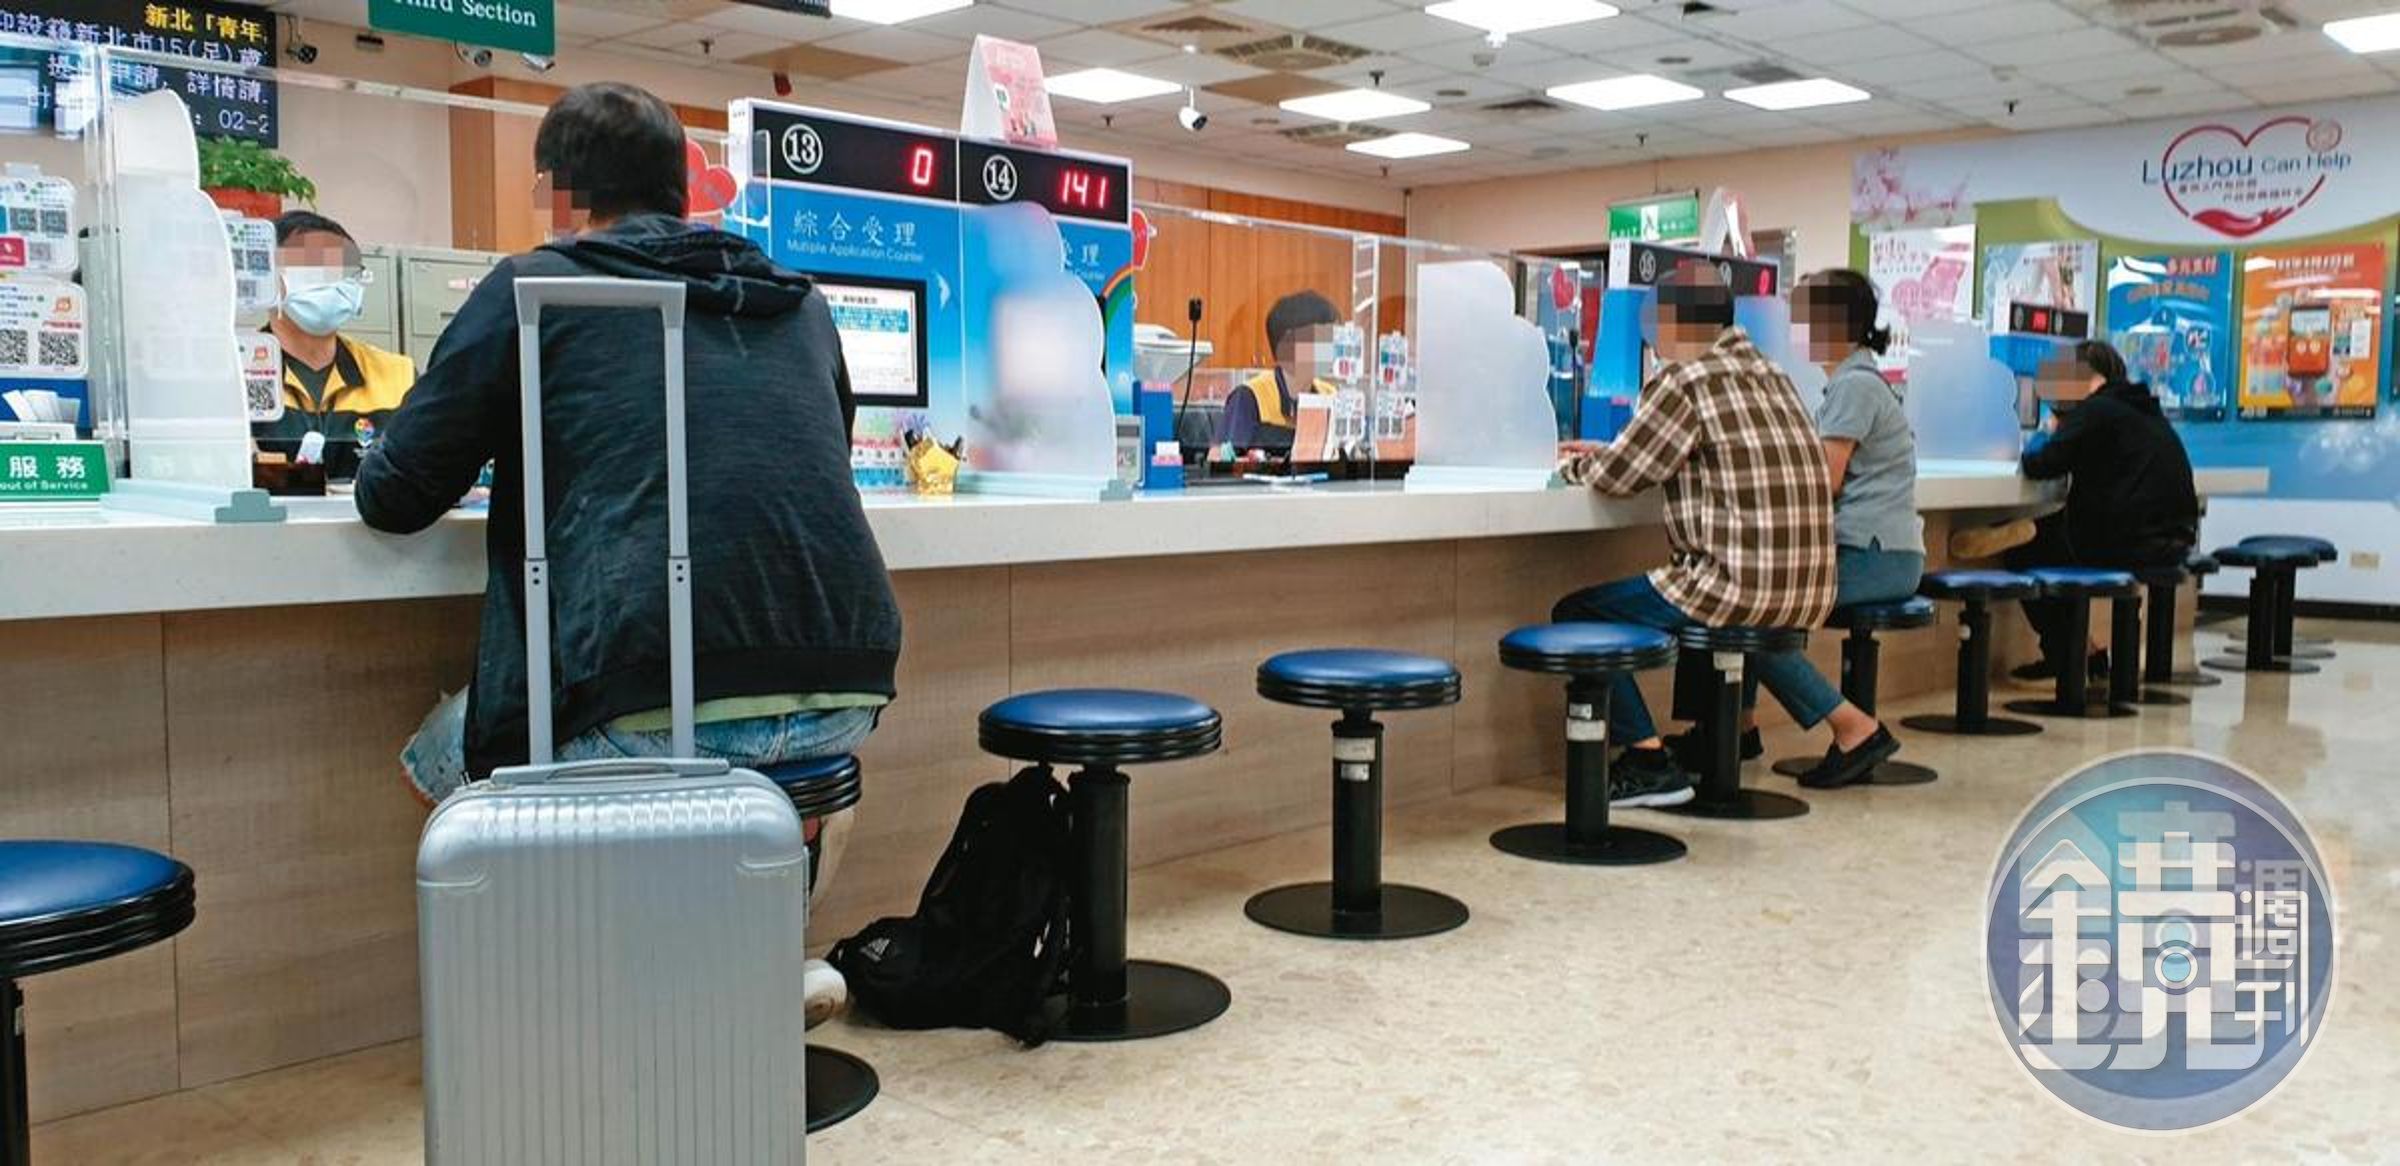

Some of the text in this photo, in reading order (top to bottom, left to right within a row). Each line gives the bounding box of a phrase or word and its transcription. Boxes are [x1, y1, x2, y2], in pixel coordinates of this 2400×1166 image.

[144, 3, 269, 43] 新北「青年
[460, 0, 537, 27] Section
[911, 148, 934, 187] 0
[1061, 171, 1107, 208] 141
[2142, 150, 2351, 184] Luzhou Can Help
[793, 209, 917, 247] 綜合受理
[829, 242, 885, 258] Application
[9, 455, 86, 479] 服務
[40, 480, 89, 491] Service
